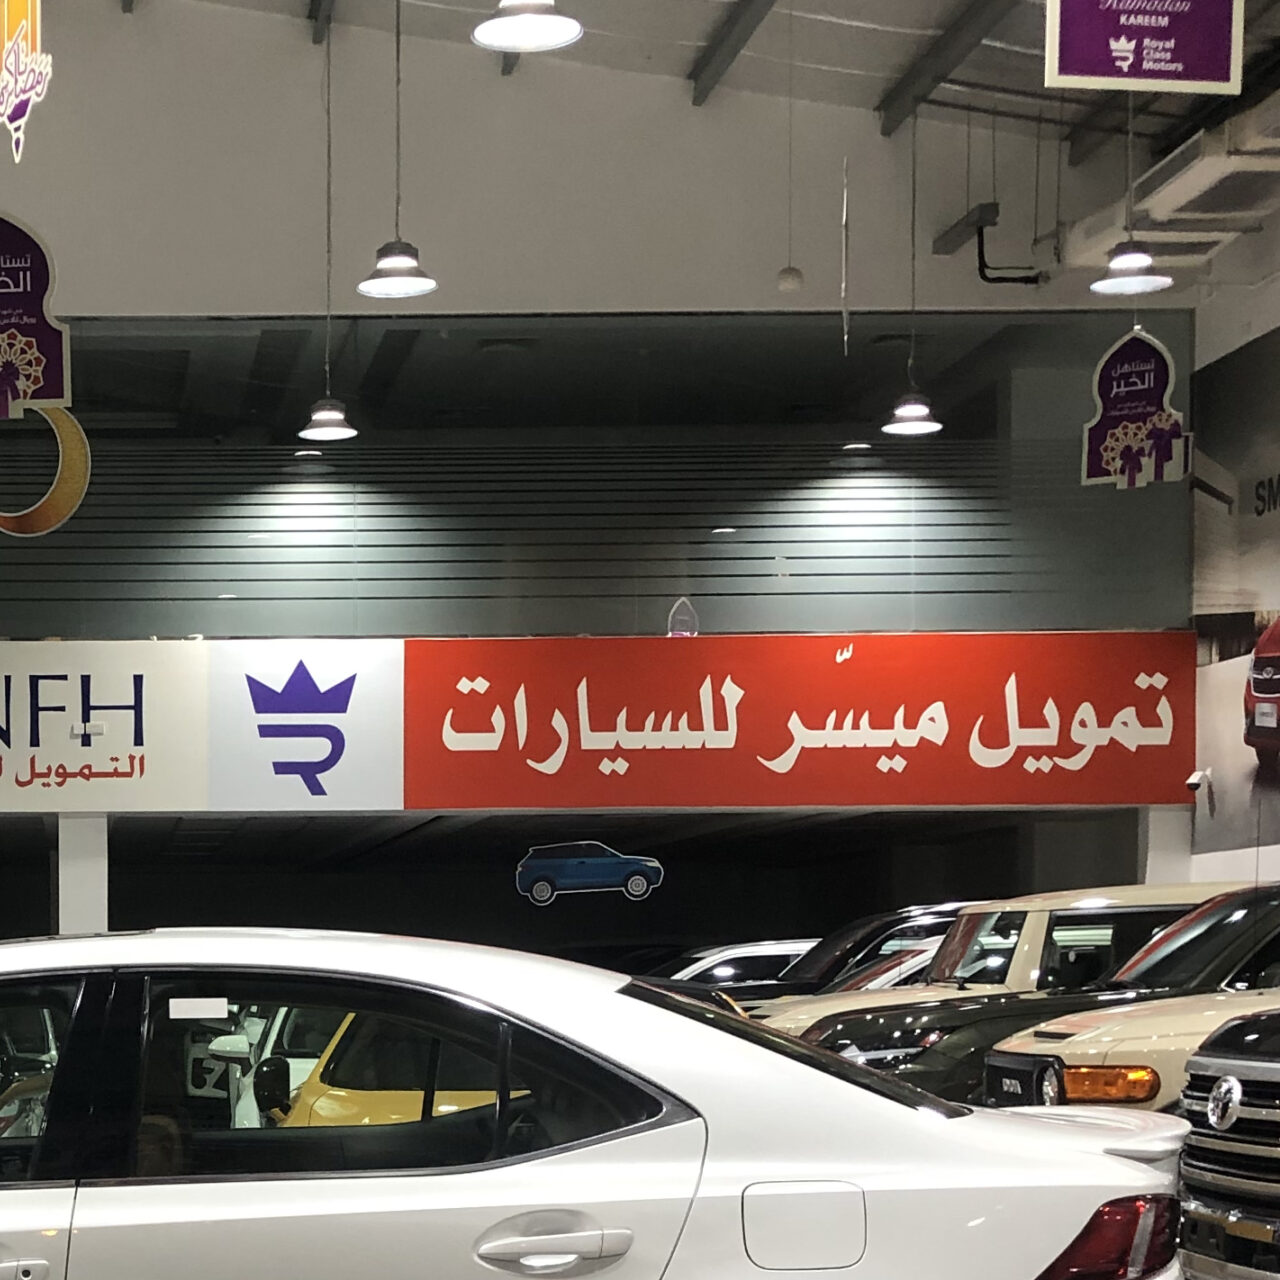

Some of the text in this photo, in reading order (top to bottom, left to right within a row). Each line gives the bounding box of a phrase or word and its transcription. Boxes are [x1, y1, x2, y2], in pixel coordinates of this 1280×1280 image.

[1120, 13, 1169, 28] KAREEM
[1142, 38, 1175, 51] Royal
[1142, 49, 1172, 60] Class
[1142, 60, 1185, 72] Motors
[1109, 371, 1155, 399] الخير
[442, 674, 745, 777] للسيارات
[967, 671, 1174, 774] تمويل
[15, 753, 146, 788] التمويل
